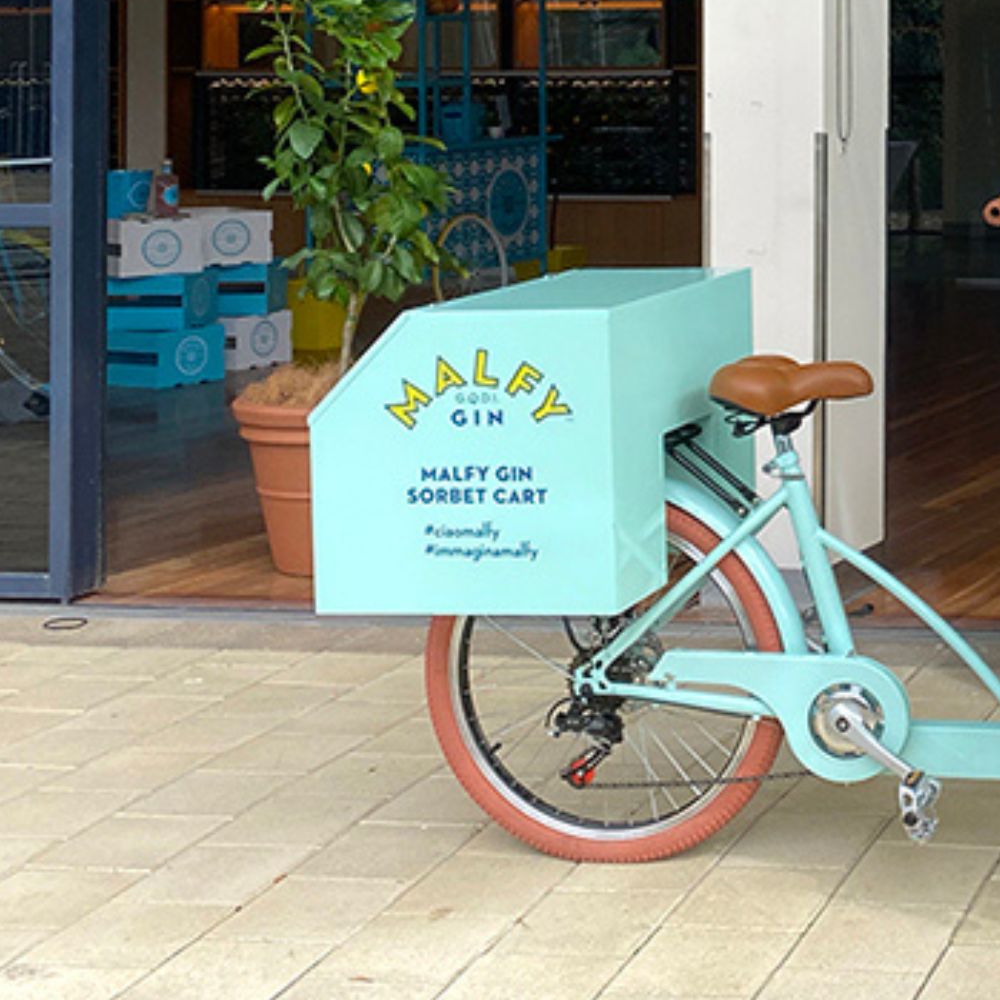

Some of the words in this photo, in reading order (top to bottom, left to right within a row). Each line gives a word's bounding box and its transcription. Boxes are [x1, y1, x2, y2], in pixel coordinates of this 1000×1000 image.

[384, 348, 572, 430] MALFY
[450, 408, 504, 427] GIN
[421, 465, 489, 482] MALFY
[495, 465, 534, 482] GIN
[406, 487, 488, 505] SORBET
[492, 488, 548, 505] CART
